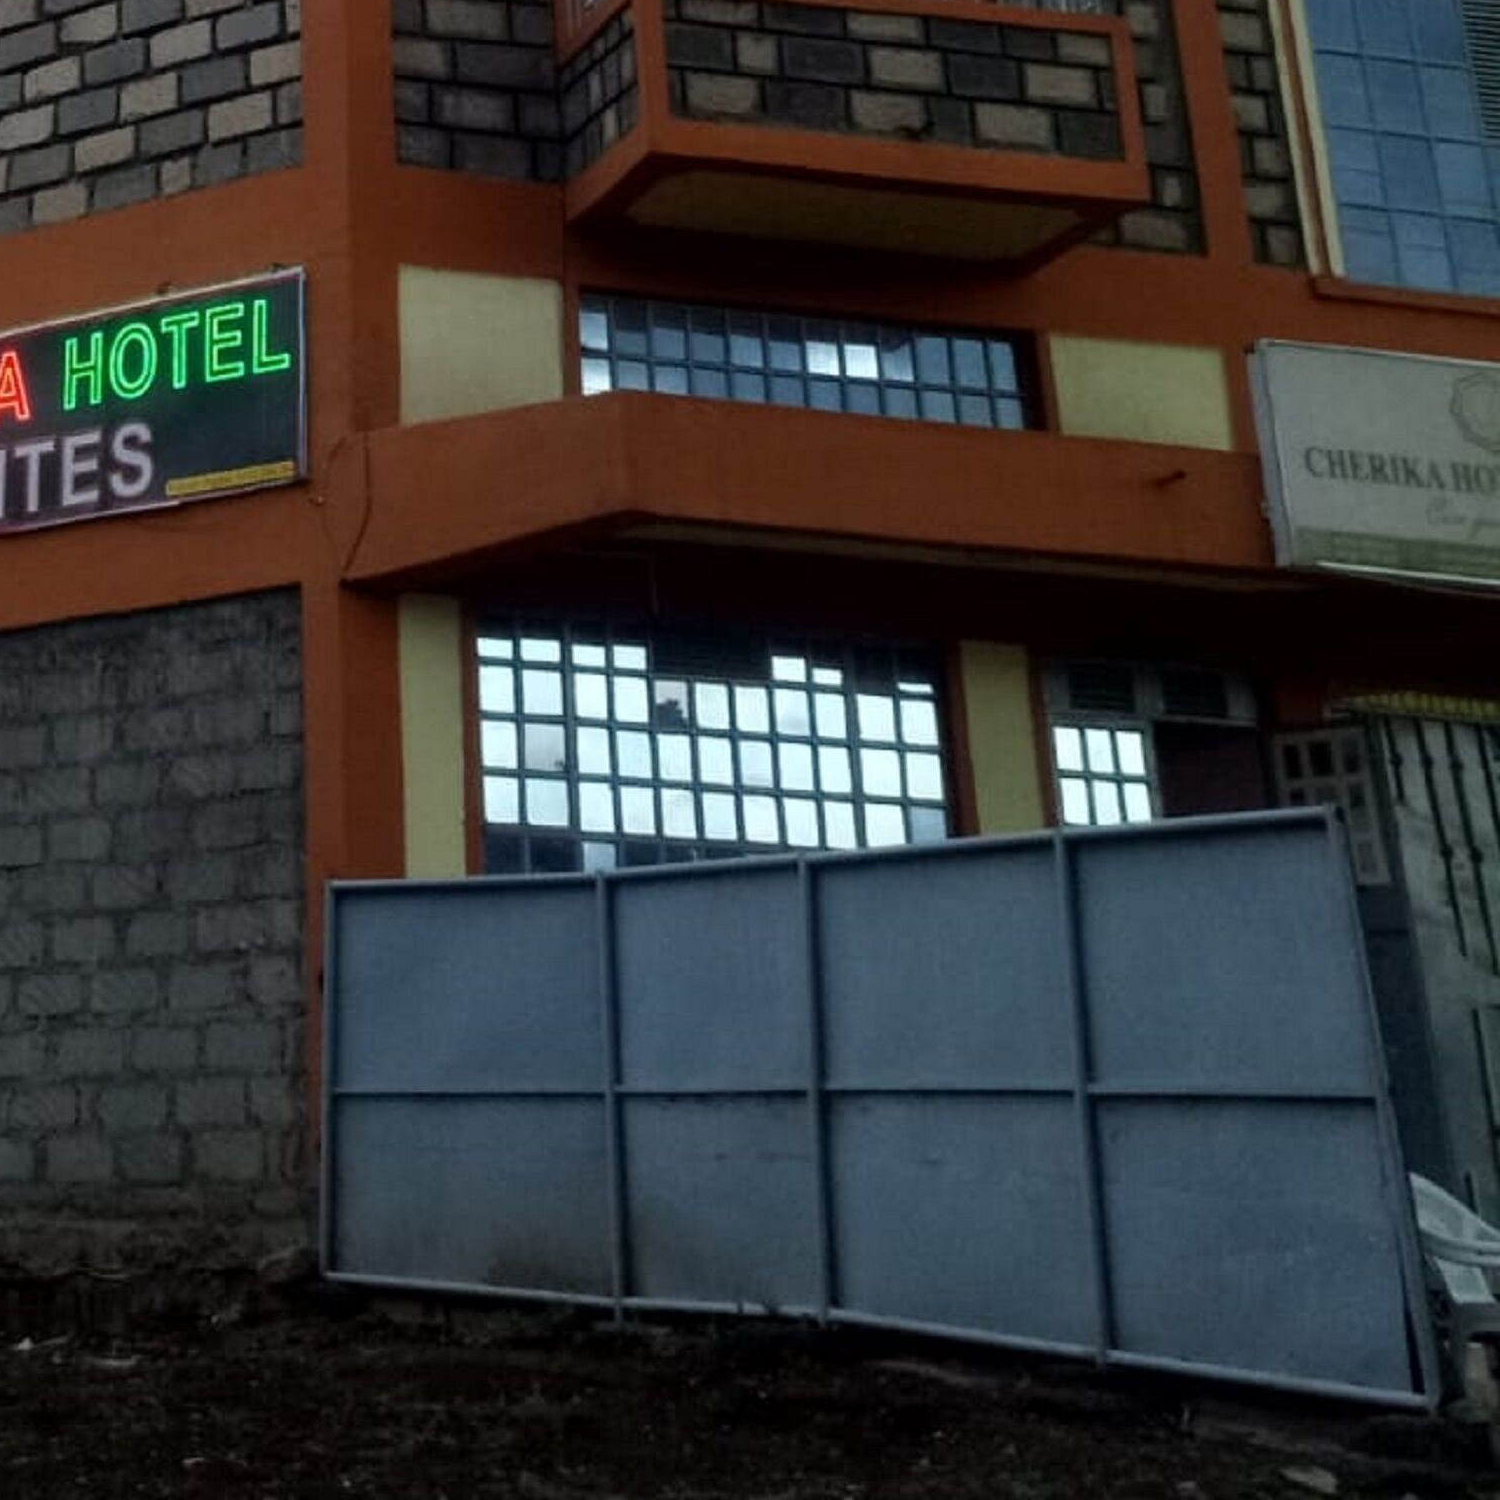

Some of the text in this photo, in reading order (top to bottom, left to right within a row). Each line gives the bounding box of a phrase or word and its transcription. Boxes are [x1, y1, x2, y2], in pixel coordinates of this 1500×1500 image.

[61, 298, 291, 410] HOTEL
[1303, 447, 1500, 497] CHERIKA HO
